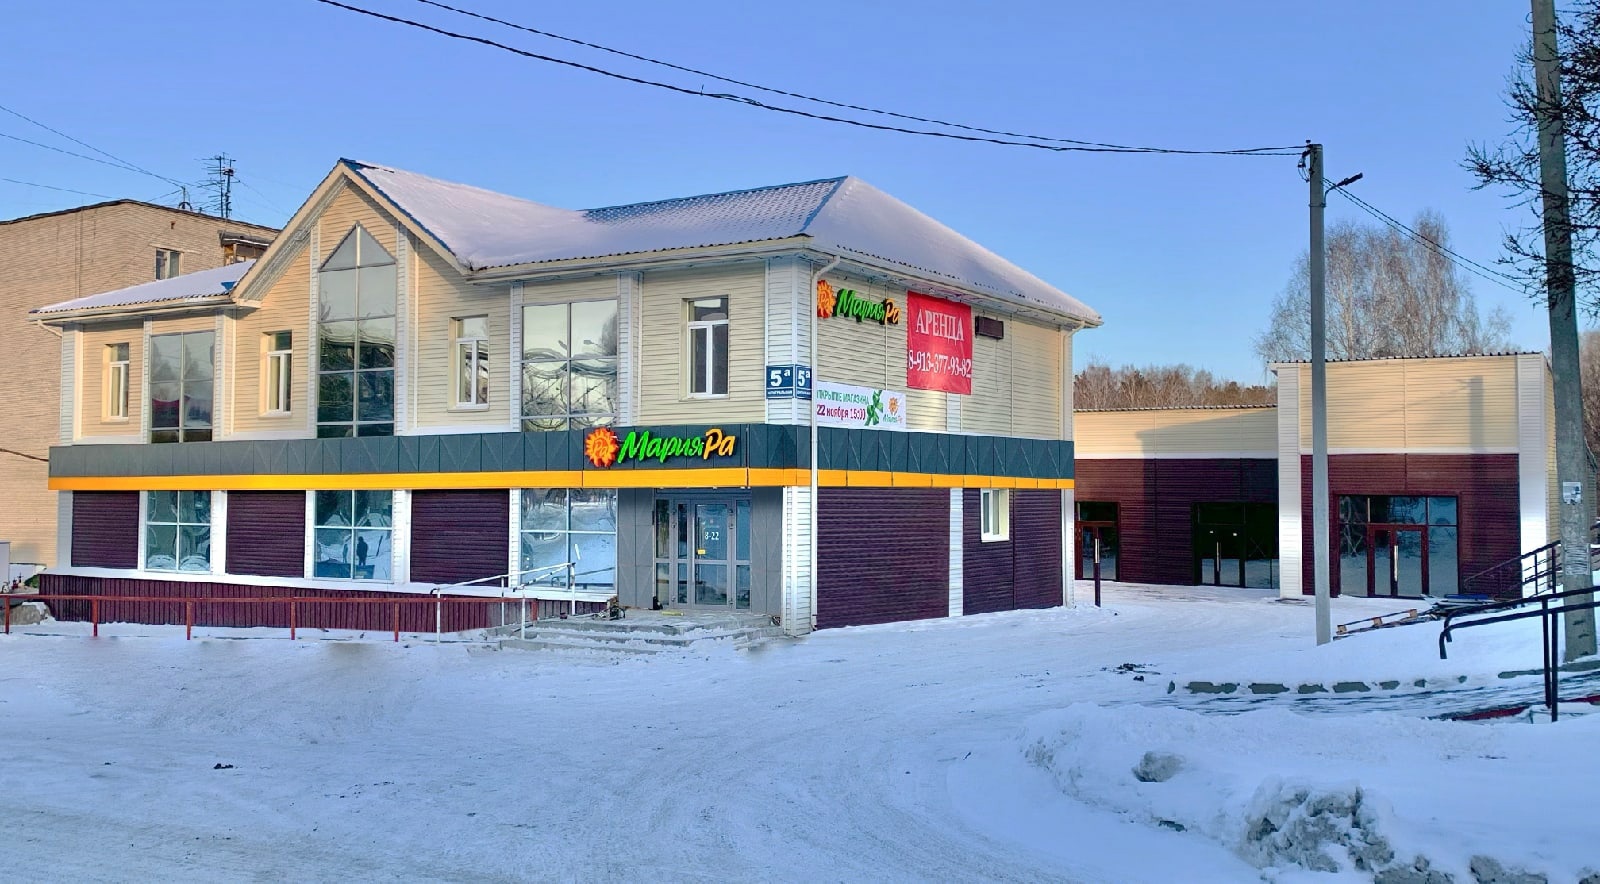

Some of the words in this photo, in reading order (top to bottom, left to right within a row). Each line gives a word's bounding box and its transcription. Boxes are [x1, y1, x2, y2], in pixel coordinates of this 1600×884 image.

[915, 308, 965, 346] АРЕНДА
[908, 349, 972, 378] 8-913-377-93-82
[816, 404, 826, 416] 22
[826, 406, 849, 420] ноября
[704, 531, 720, 541] 8-22
